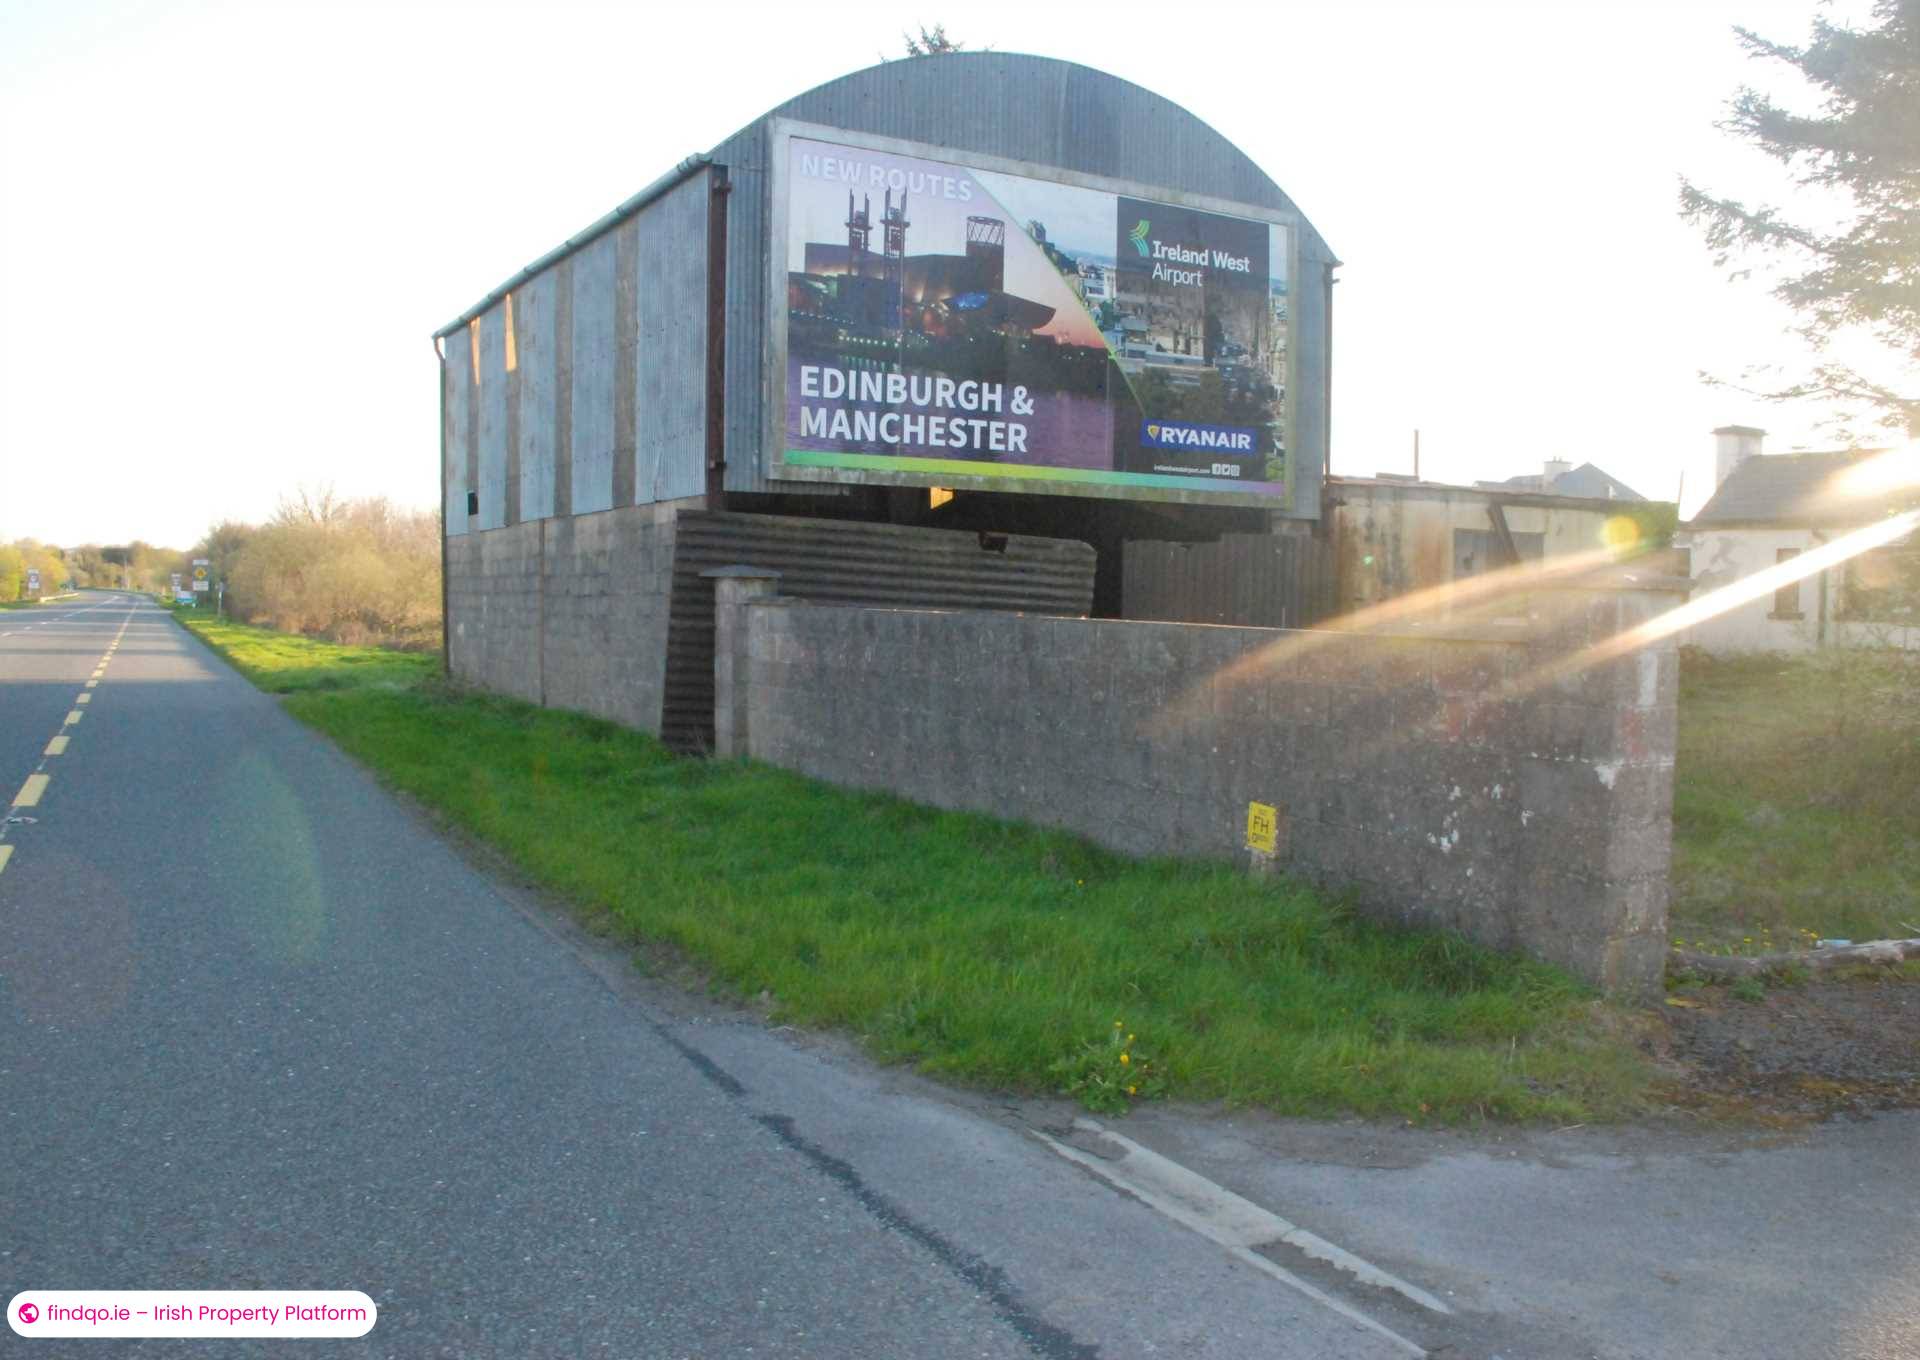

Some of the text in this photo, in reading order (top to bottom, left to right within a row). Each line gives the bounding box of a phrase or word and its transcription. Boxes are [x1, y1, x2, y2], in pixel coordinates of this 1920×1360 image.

[801, 153, 973, 201] NEW ROUTES
[1152, 240, 1250, 273] Ireland West
[1151, 262, 1203, 287] Airport
[800, 365, 1034, 416] EDINBURGH &
[800, 405, 1028, 453] MANCHESTER
[1161, 426, 1251, 450] RYANAIR
[1253, 815, 1269, 834] FH
